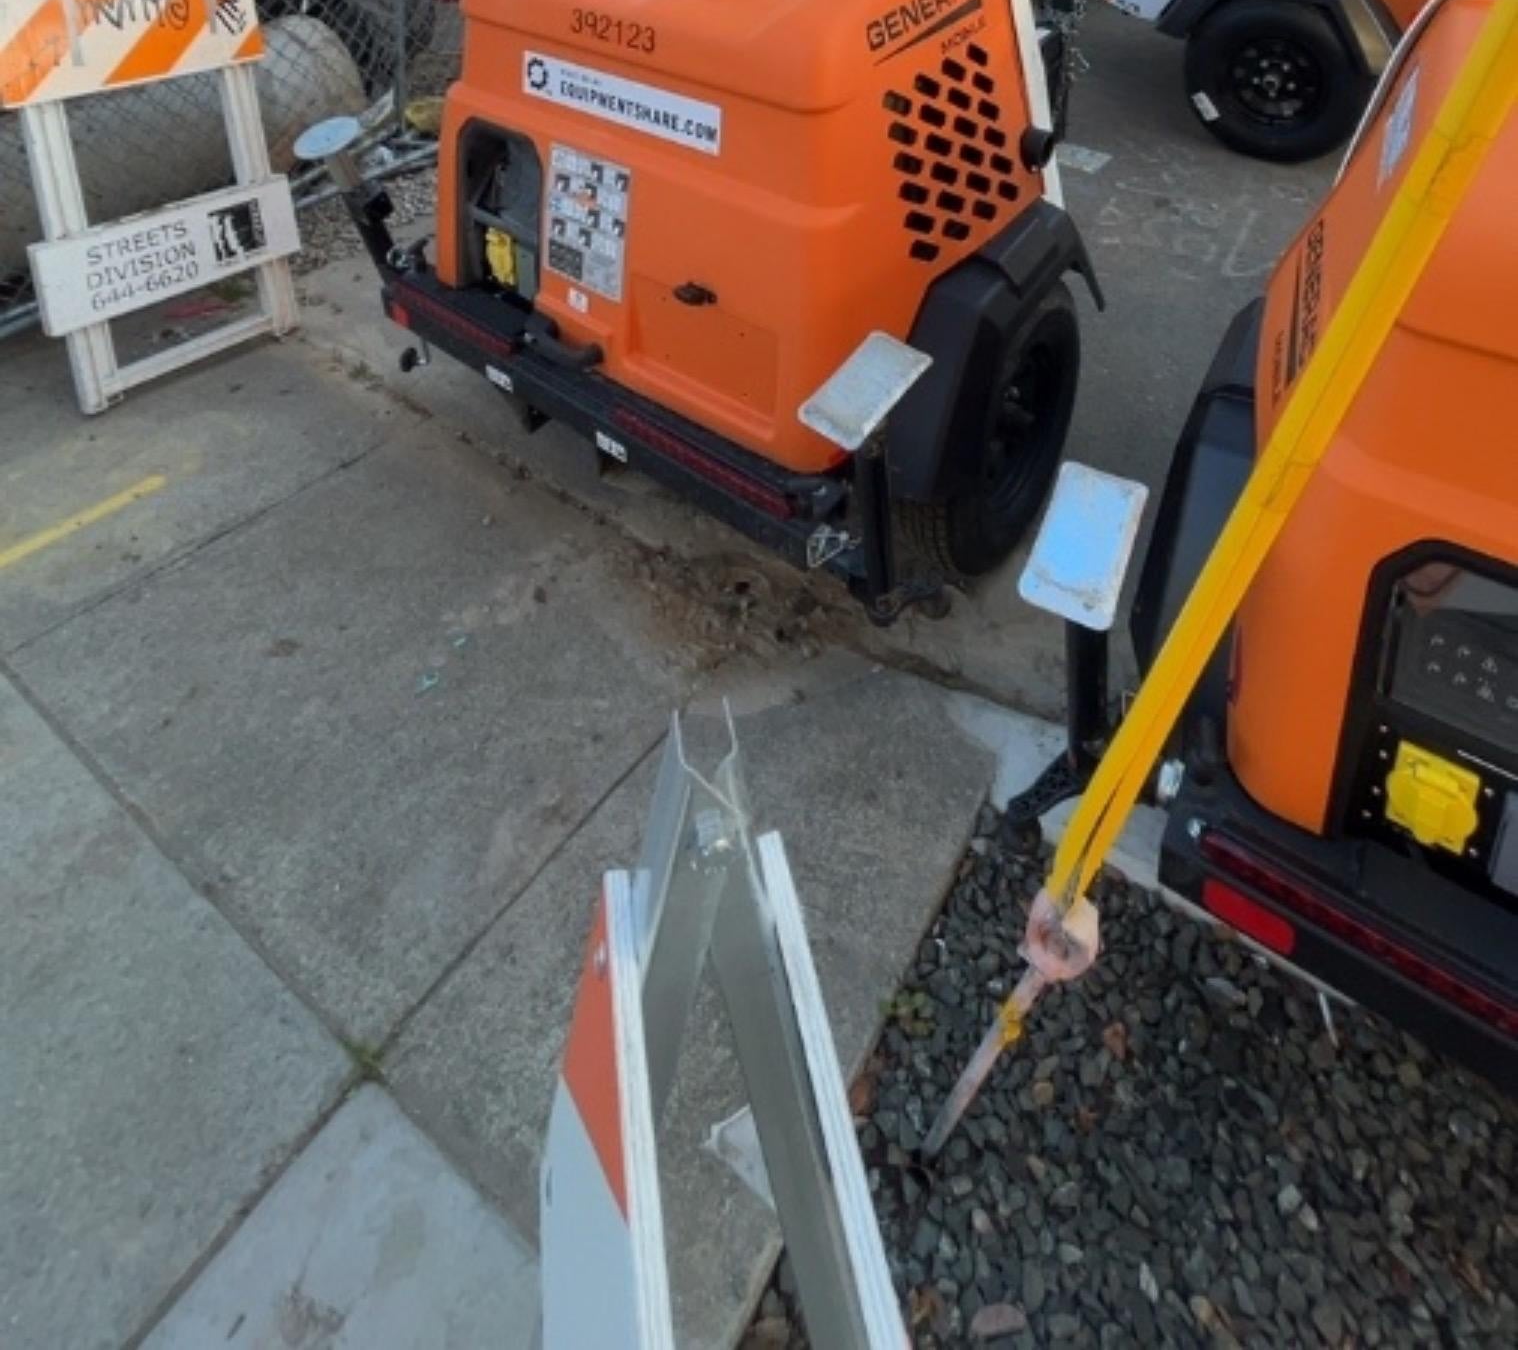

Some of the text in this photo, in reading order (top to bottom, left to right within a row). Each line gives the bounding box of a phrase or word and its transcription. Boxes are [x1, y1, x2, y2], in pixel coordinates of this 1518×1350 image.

[570, 7, 656, 54] 392123
[559, 79, 719, 142] EQUIPMENTSHARE.COM
[86, 220, 187, 266] STREETS
[86, 240, 197, 292] DIVISION
[92, 261, 200, 310] 644-6620
